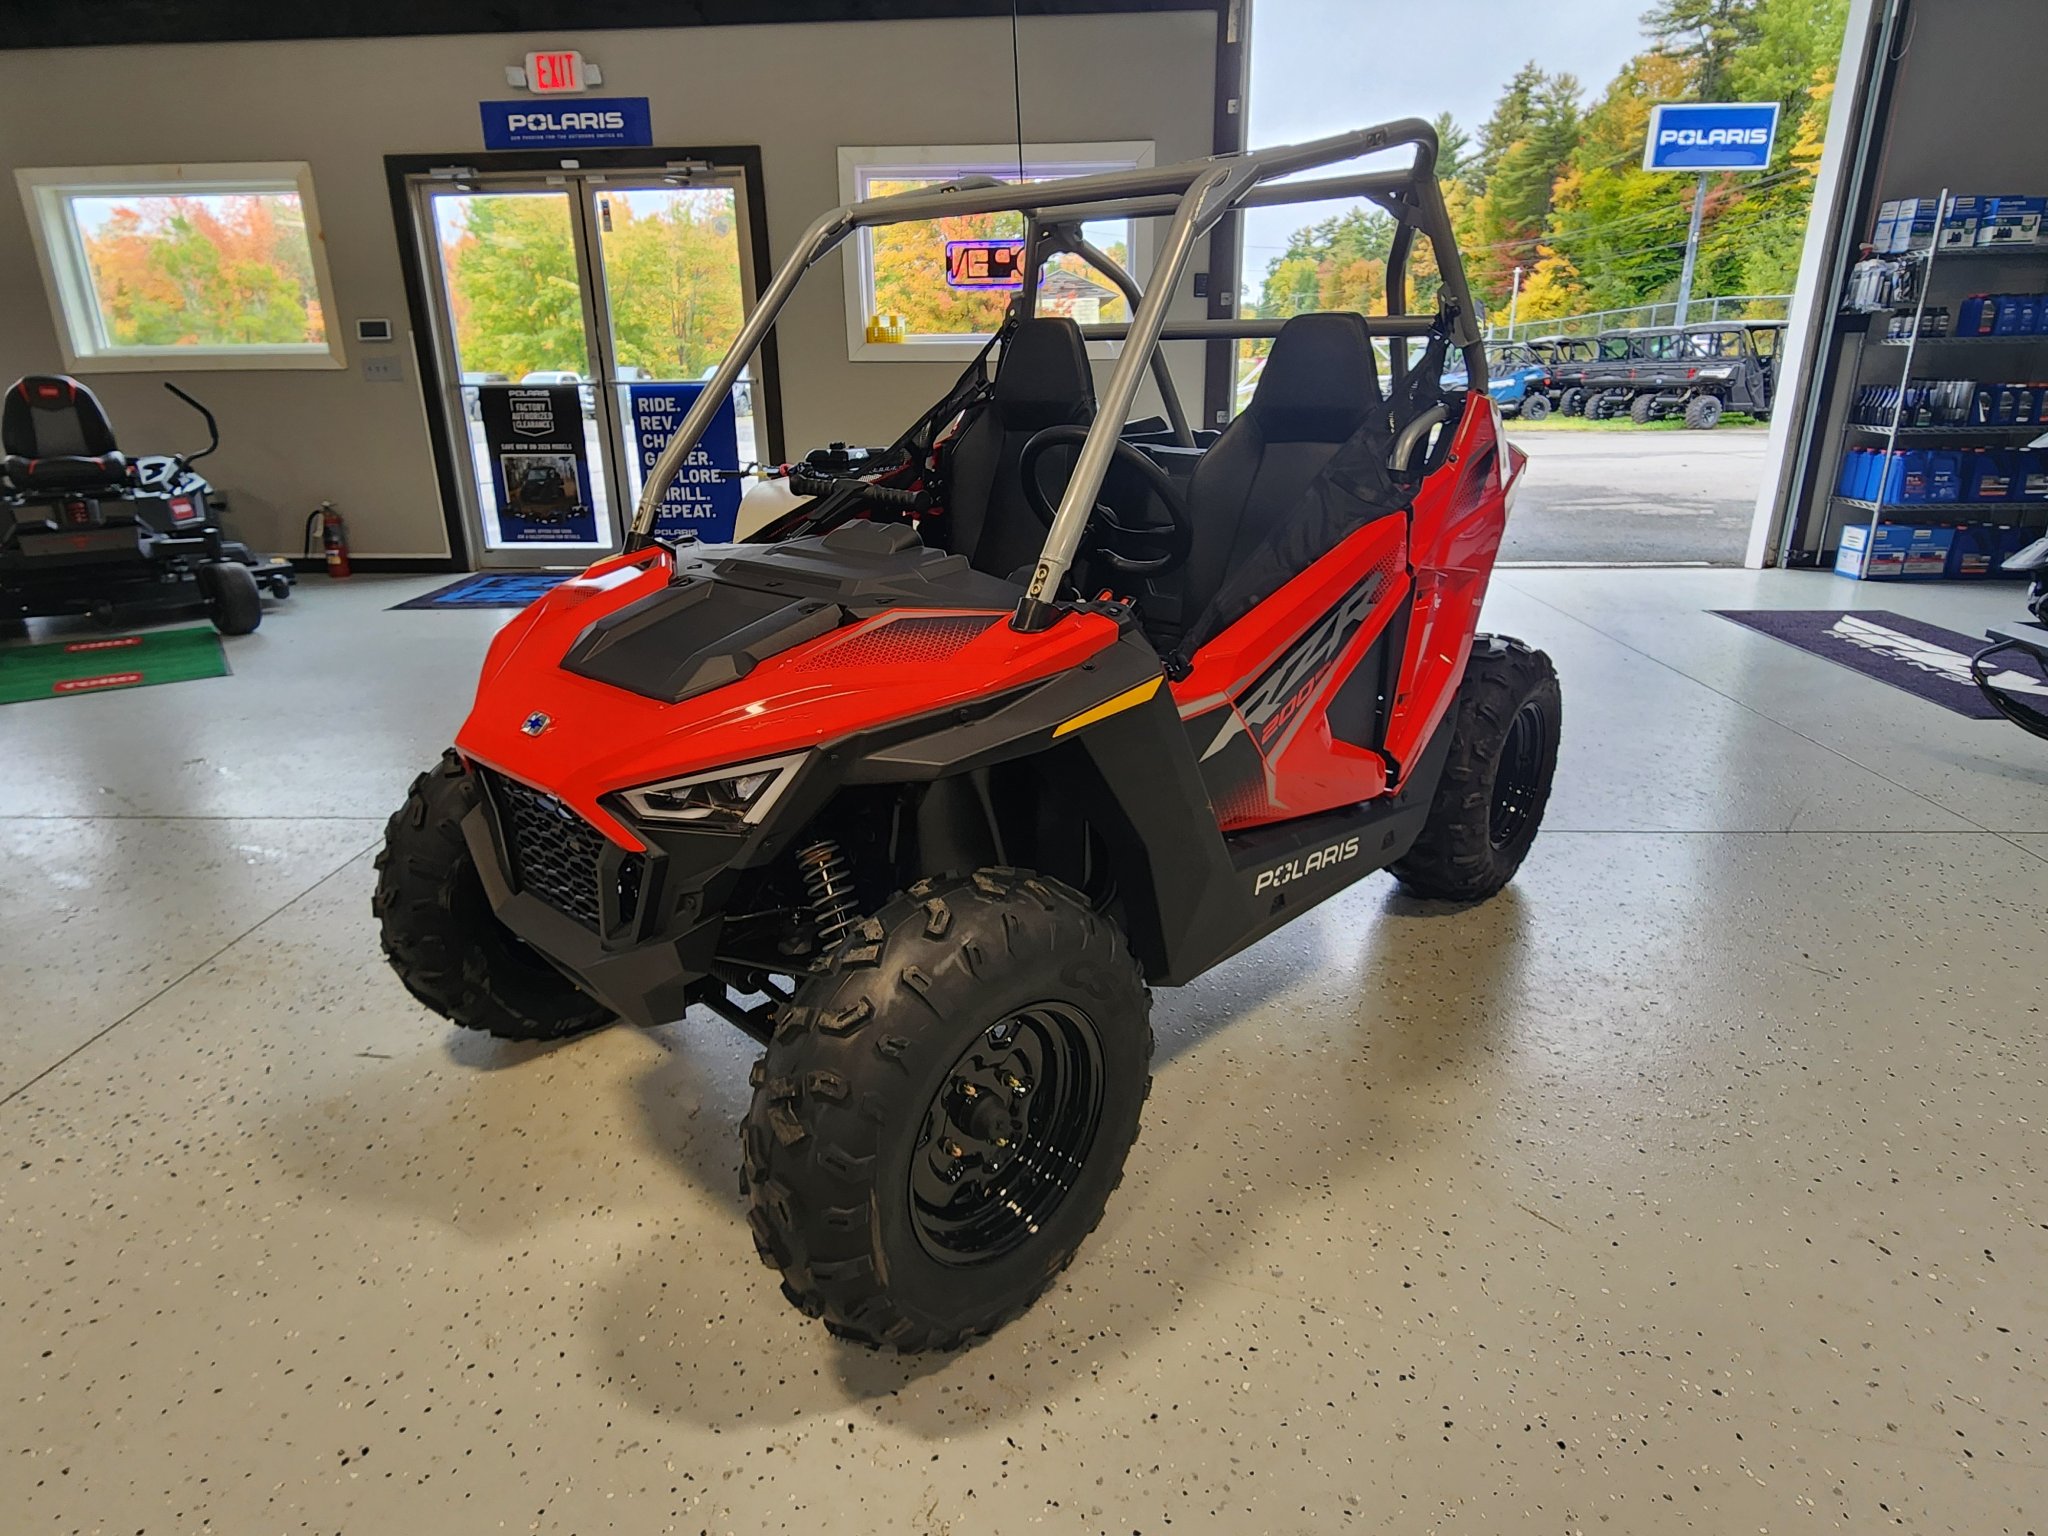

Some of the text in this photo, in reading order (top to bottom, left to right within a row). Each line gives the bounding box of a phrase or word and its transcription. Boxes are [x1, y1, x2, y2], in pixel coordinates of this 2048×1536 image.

[535, 53, 574, 89] EXIT
[507, 111, 625, 132] POLARIS
[1659, 128, 1768, 146] POLARIS
[507, 389, 551, 397] POLARIS
[515, 402, 547, 412] FACTORY
[637, 397, 682, 413] RIDE.
[511, 411, 554, 421] AUTHORIZED
[640, 415, 678, 431] REV.
[515, 420, 552, 429] CLEARANCE
[653, 528, 699, 536] POLARIS
[1230, 571, 1384, 733] RZR
[1254, 836, 1360, 896] POLARIS
